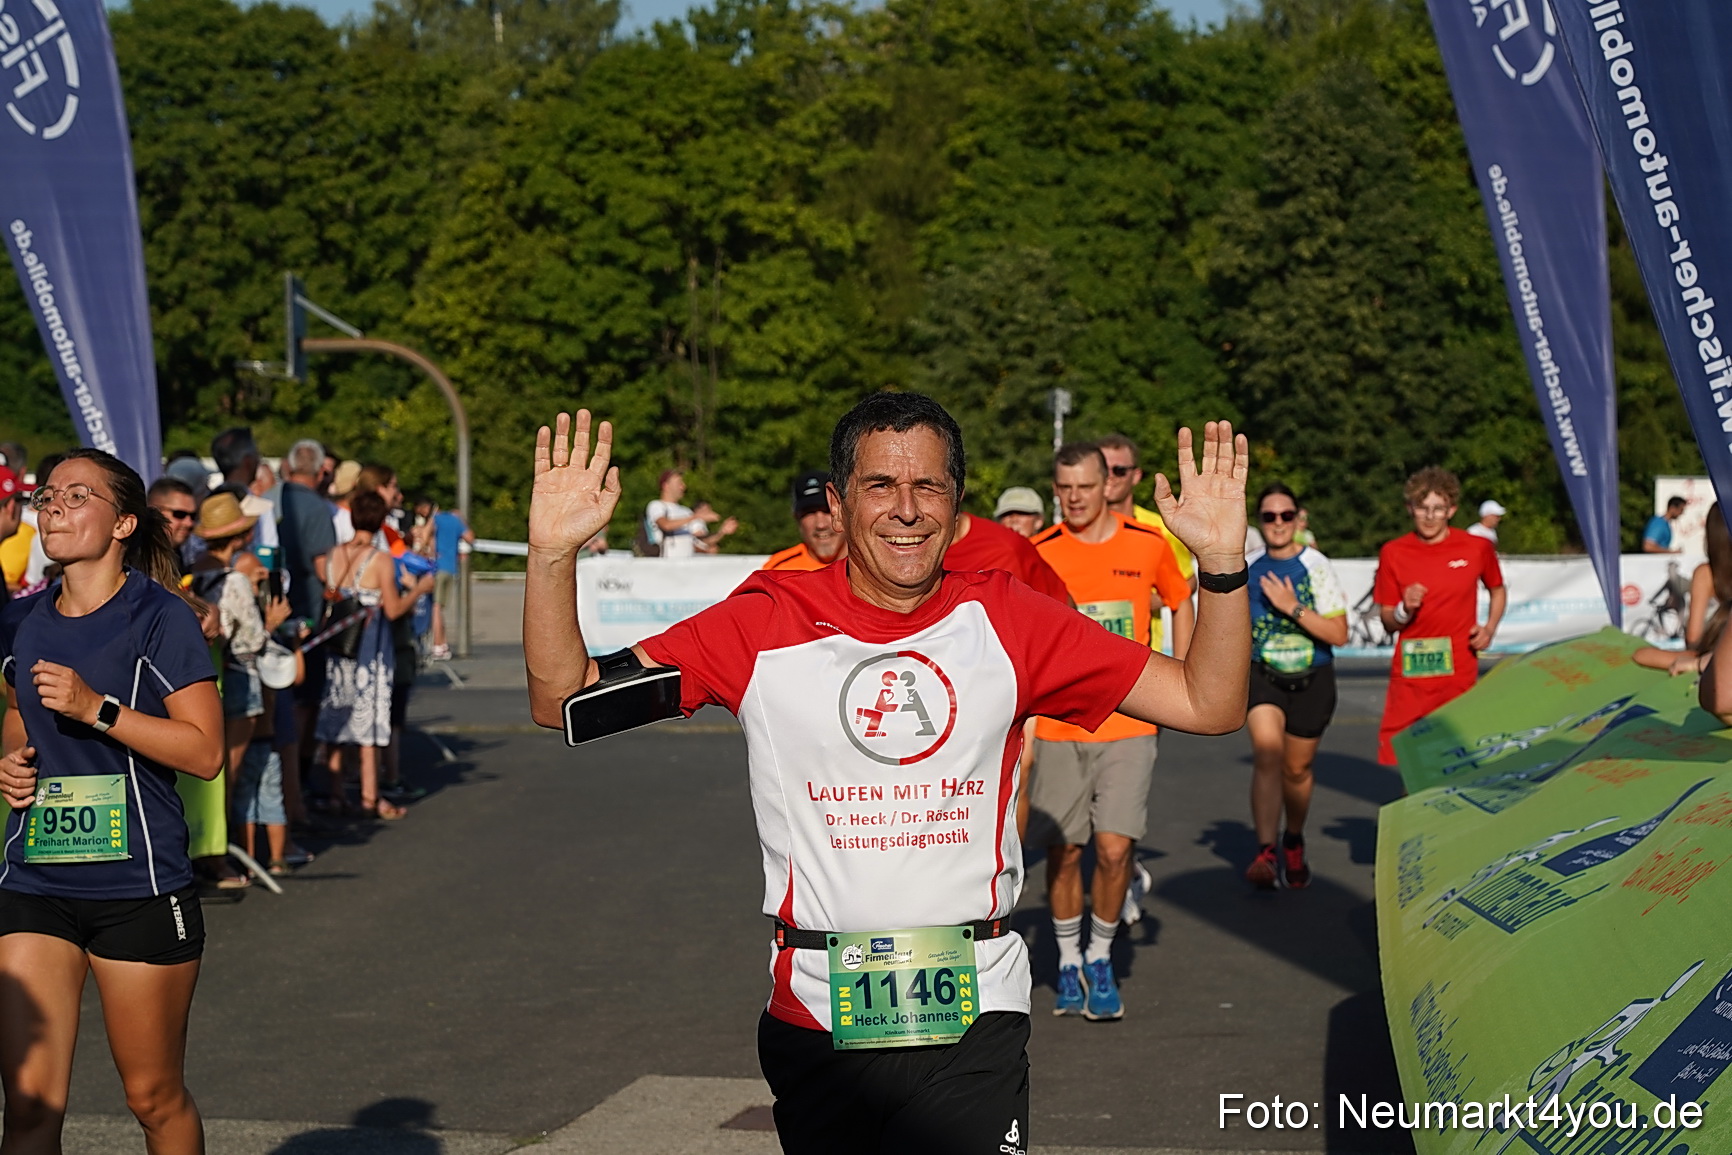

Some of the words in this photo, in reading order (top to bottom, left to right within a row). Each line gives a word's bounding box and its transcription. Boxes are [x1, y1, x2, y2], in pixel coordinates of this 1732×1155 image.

[1098, 618, 1122, 633] 01
[43, 806, 96, 834] 950
[110, 809, 121, 848] 2022
[826, 813, 846, 826] Dr.
[850, 812, 886, 826] Heck
[890, 811, 897, 826] /
[901, 811, 922, 824] Dr.
[926, 807, 969, 822] Röschl
[28, 817, 37, 846] RUN
[34, 838, 69, 847] Freihart
[73, 836, 109, 846] Marion
[172, 905, 186, 941] TERREX
[855, 968, 956, 1009] 1146
[959, 973, 974, 1026] 2022
[839, 986, 853, 1026] RUN
[855, 1013, 887, 1026] Heck
[892, 1011, 959, 1025] Johannes
